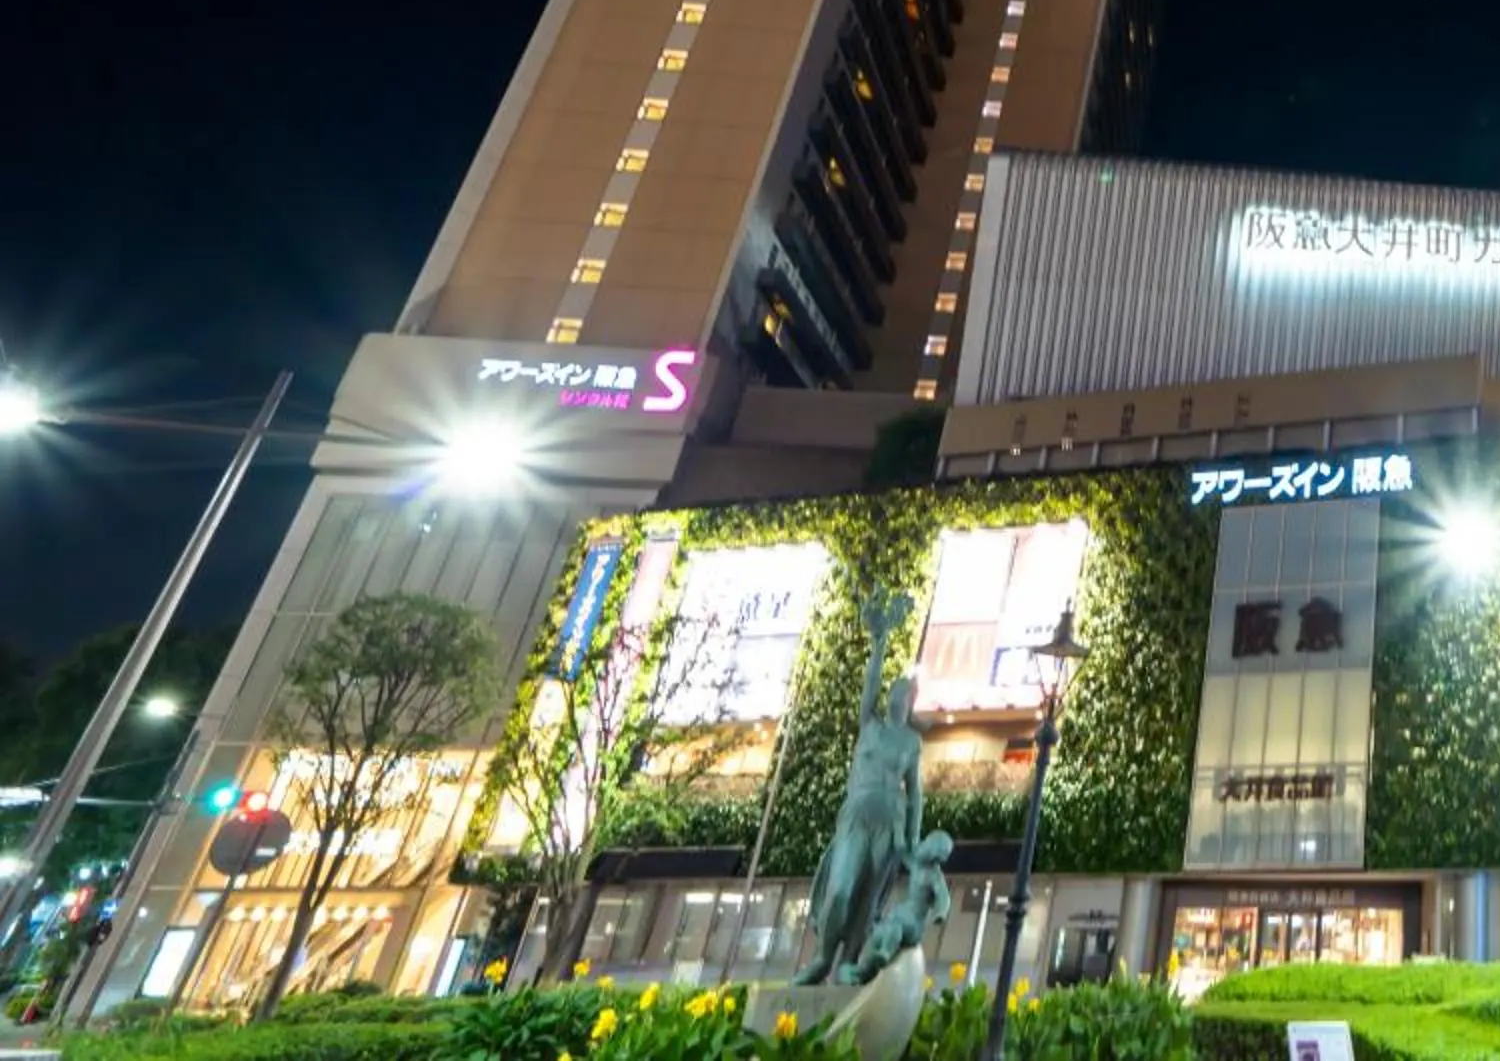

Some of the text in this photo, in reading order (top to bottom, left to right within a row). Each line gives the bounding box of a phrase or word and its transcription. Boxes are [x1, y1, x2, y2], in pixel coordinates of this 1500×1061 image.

[478, 358, 592, 386] アワーズイン
[643, 350, 695, 411] S
[1191, 454, 1413, 505] アワーズイン 阪急
